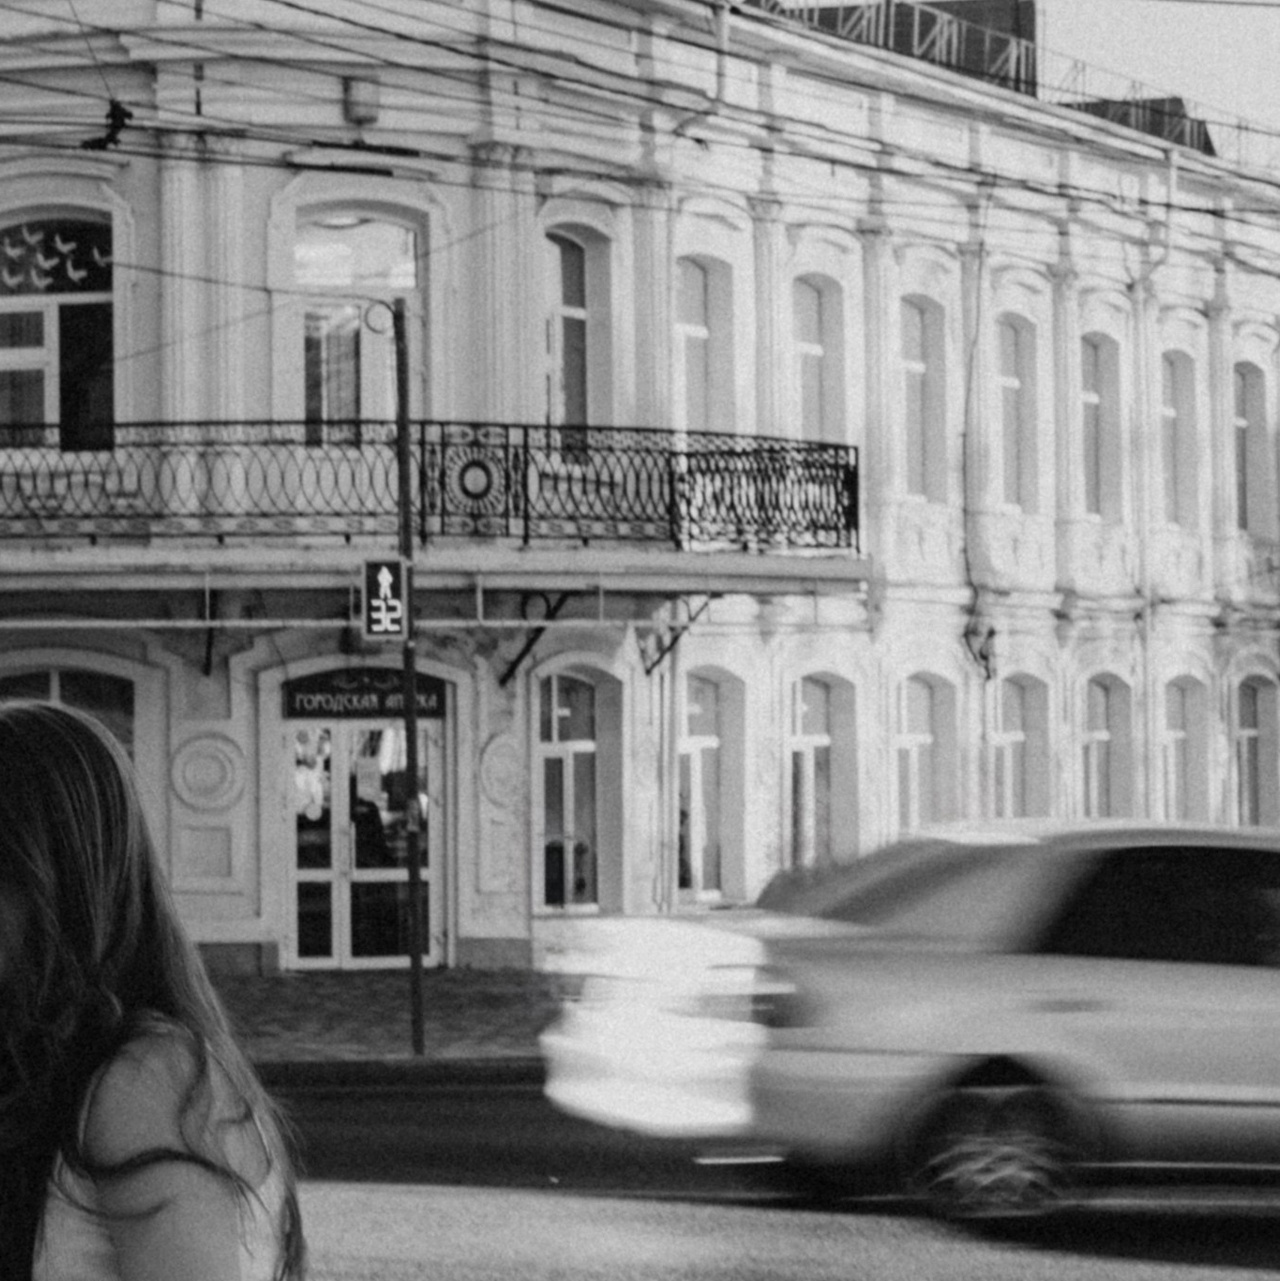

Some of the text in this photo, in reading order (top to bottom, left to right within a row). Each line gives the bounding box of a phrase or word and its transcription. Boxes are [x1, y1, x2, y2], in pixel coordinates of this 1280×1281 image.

[370, 599, 402, 632] 32
[295, 693, 437, 712] ГОРОДСКАЯ АПКА
